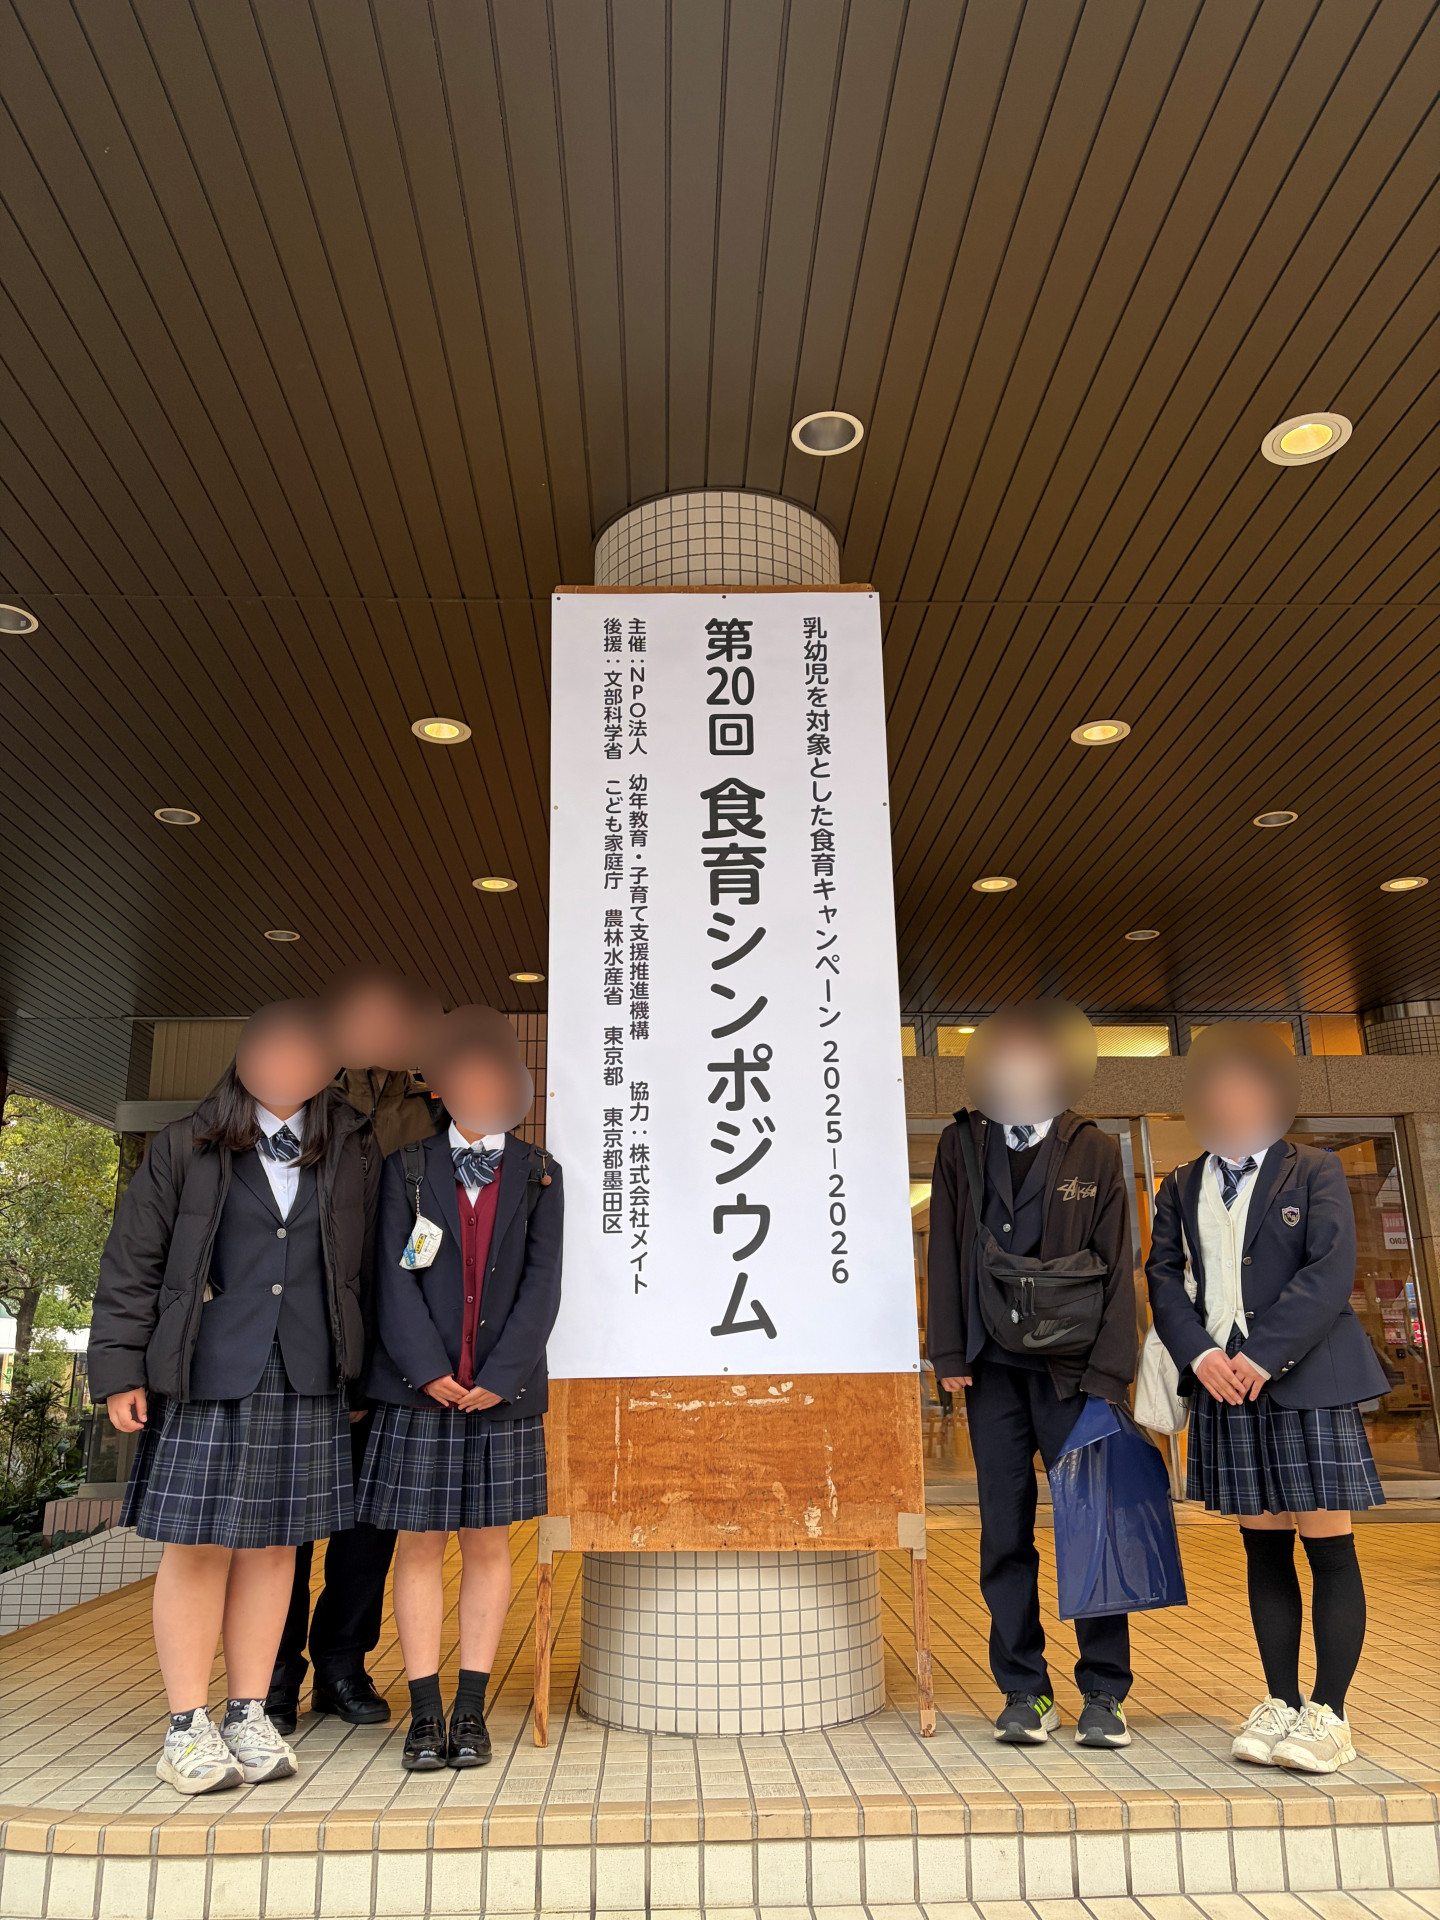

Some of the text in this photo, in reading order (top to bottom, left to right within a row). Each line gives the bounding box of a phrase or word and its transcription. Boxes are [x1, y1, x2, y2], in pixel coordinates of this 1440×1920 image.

[602, 617, 624, 1234] 後援：文部科学省 こども家庭庁 農林水産省 東京都 東京都墨田区
[628, 773, 650, 1041] 幼年教育・子育て支援推進機構
[699, 617, 778, 1340] 第20回 食育シンポジウム
[802, 616, 841, 1028] 乳幼児を対象とした食育キャンペーン
[629, 1080, 650, 1295] 協力：株式会社メイト
